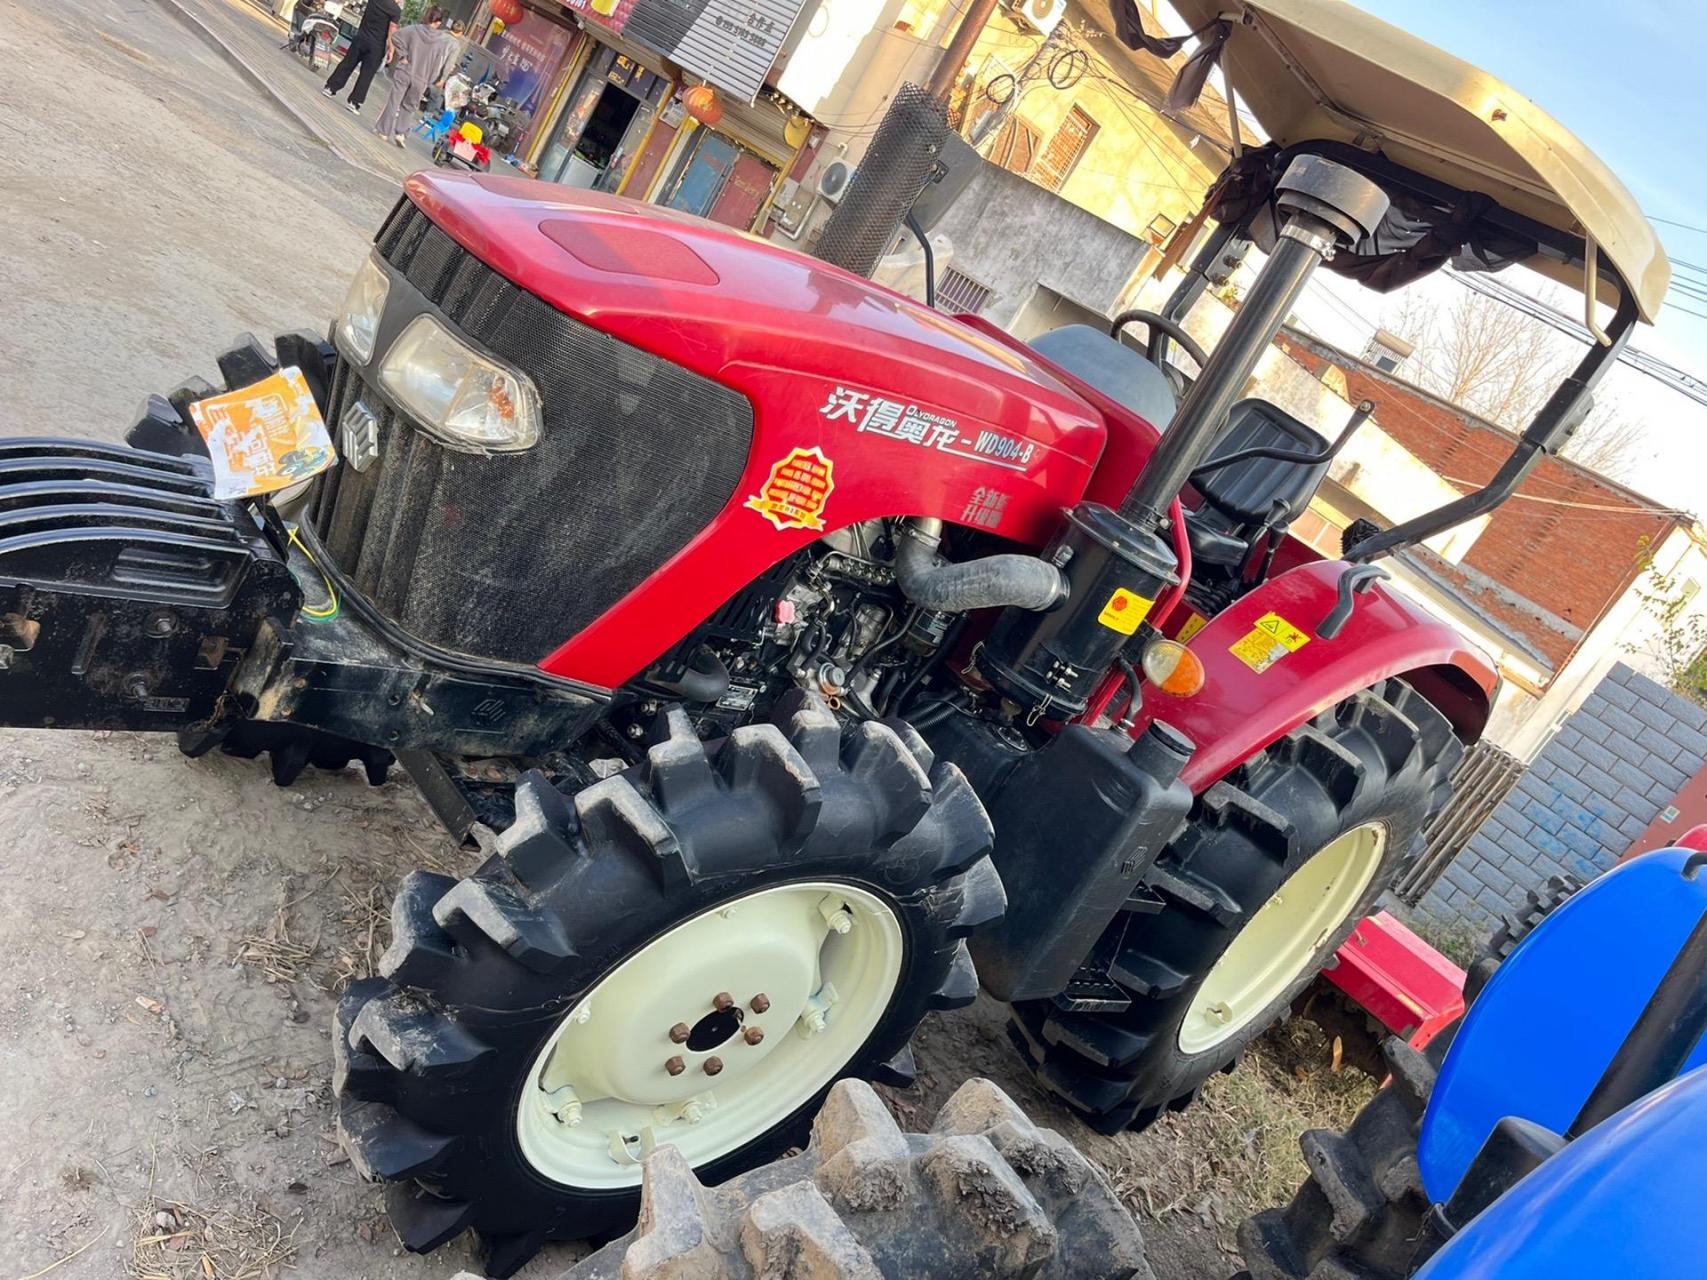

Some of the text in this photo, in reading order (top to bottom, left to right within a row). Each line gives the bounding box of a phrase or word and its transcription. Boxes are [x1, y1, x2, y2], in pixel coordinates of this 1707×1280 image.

[819, 386, 960, 448] 沃得奥龙
[973, 430, 1035, 464] WD904-B
[906, 405, 957, 428] OLYDRAGON
